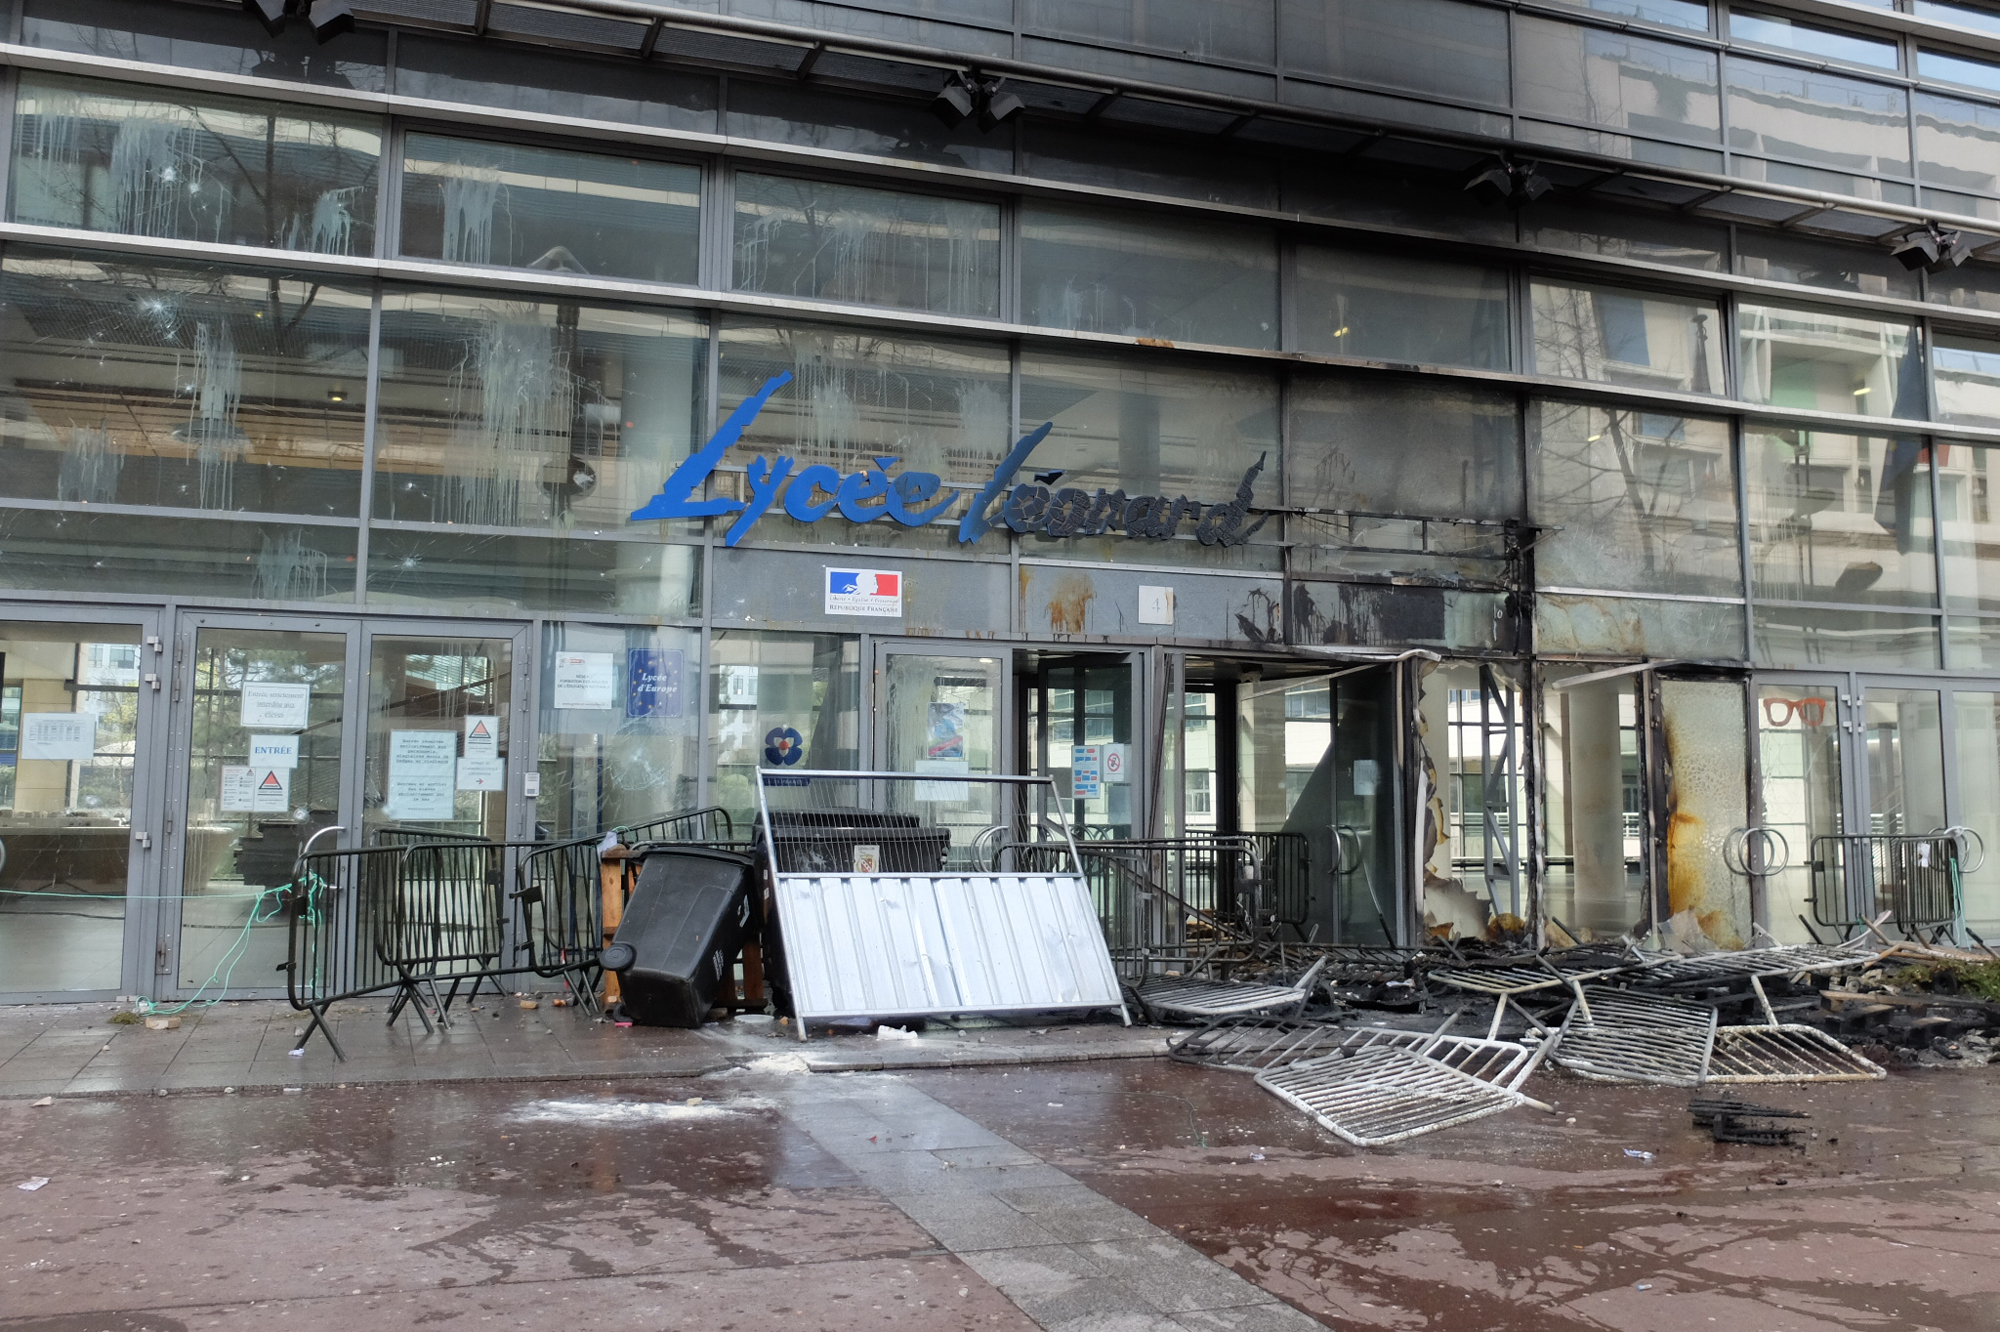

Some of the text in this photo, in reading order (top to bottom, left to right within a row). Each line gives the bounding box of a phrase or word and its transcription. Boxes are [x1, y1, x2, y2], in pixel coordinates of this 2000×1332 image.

[631, 370, 959, 547] Lycée
[642, 672, 668, 682] Lycée
[637, 683, 678, 693] d'Europe
[254, 745, 292, 755] ENTRÉE
